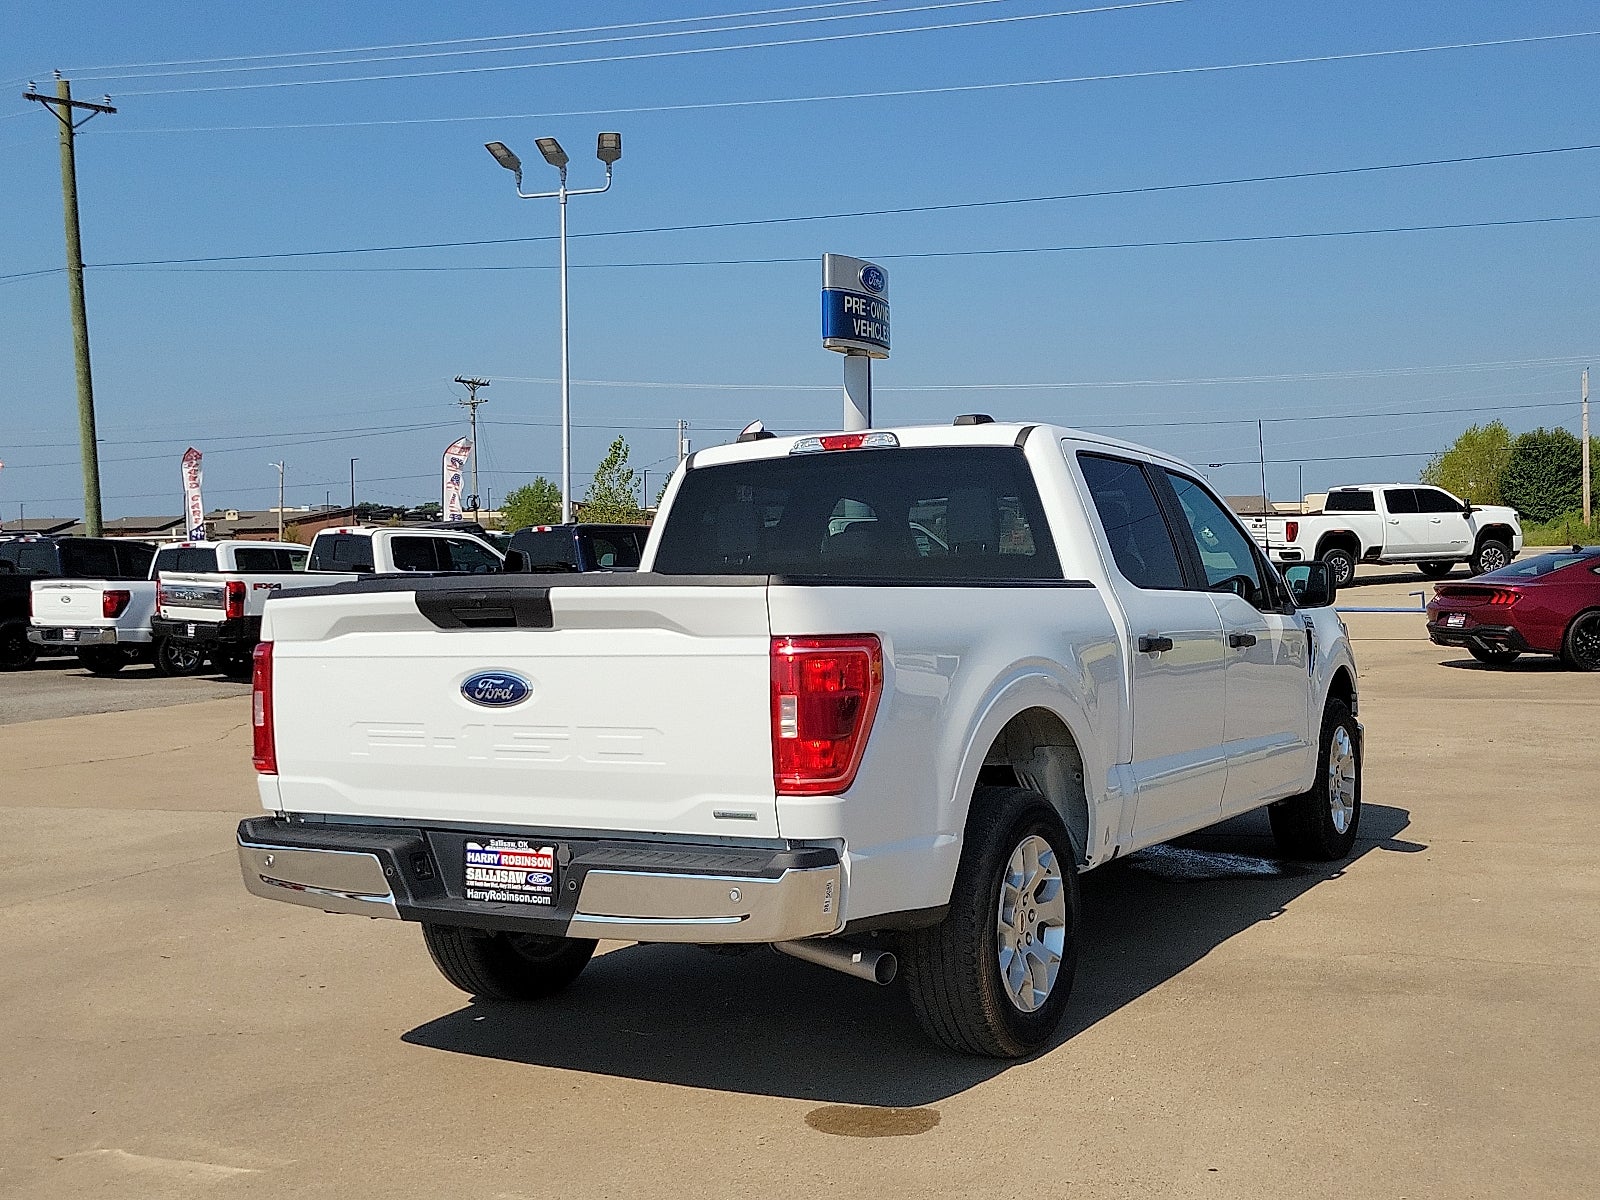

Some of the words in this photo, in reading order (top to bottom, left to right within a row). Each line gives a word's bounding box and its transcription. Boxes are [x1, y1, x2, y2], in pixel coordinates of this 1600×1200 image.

[844, 296, 890, 323] PRE-OWNE
[853, 318, 890, 343] VEHICLES
[253, 583, 282, 591] FX4
[474, 678, 515, 701] Ford
[349, 721, 666, 765] F-150
[517, 841, 529, 849] OK
[467, 851, 500, 865] HARRY
[500, 854, 552, 869] ROBINSON
[466, 867, 527, 884] SALLISAW
[466, 889, 551, 905] HarryRobinson.com
